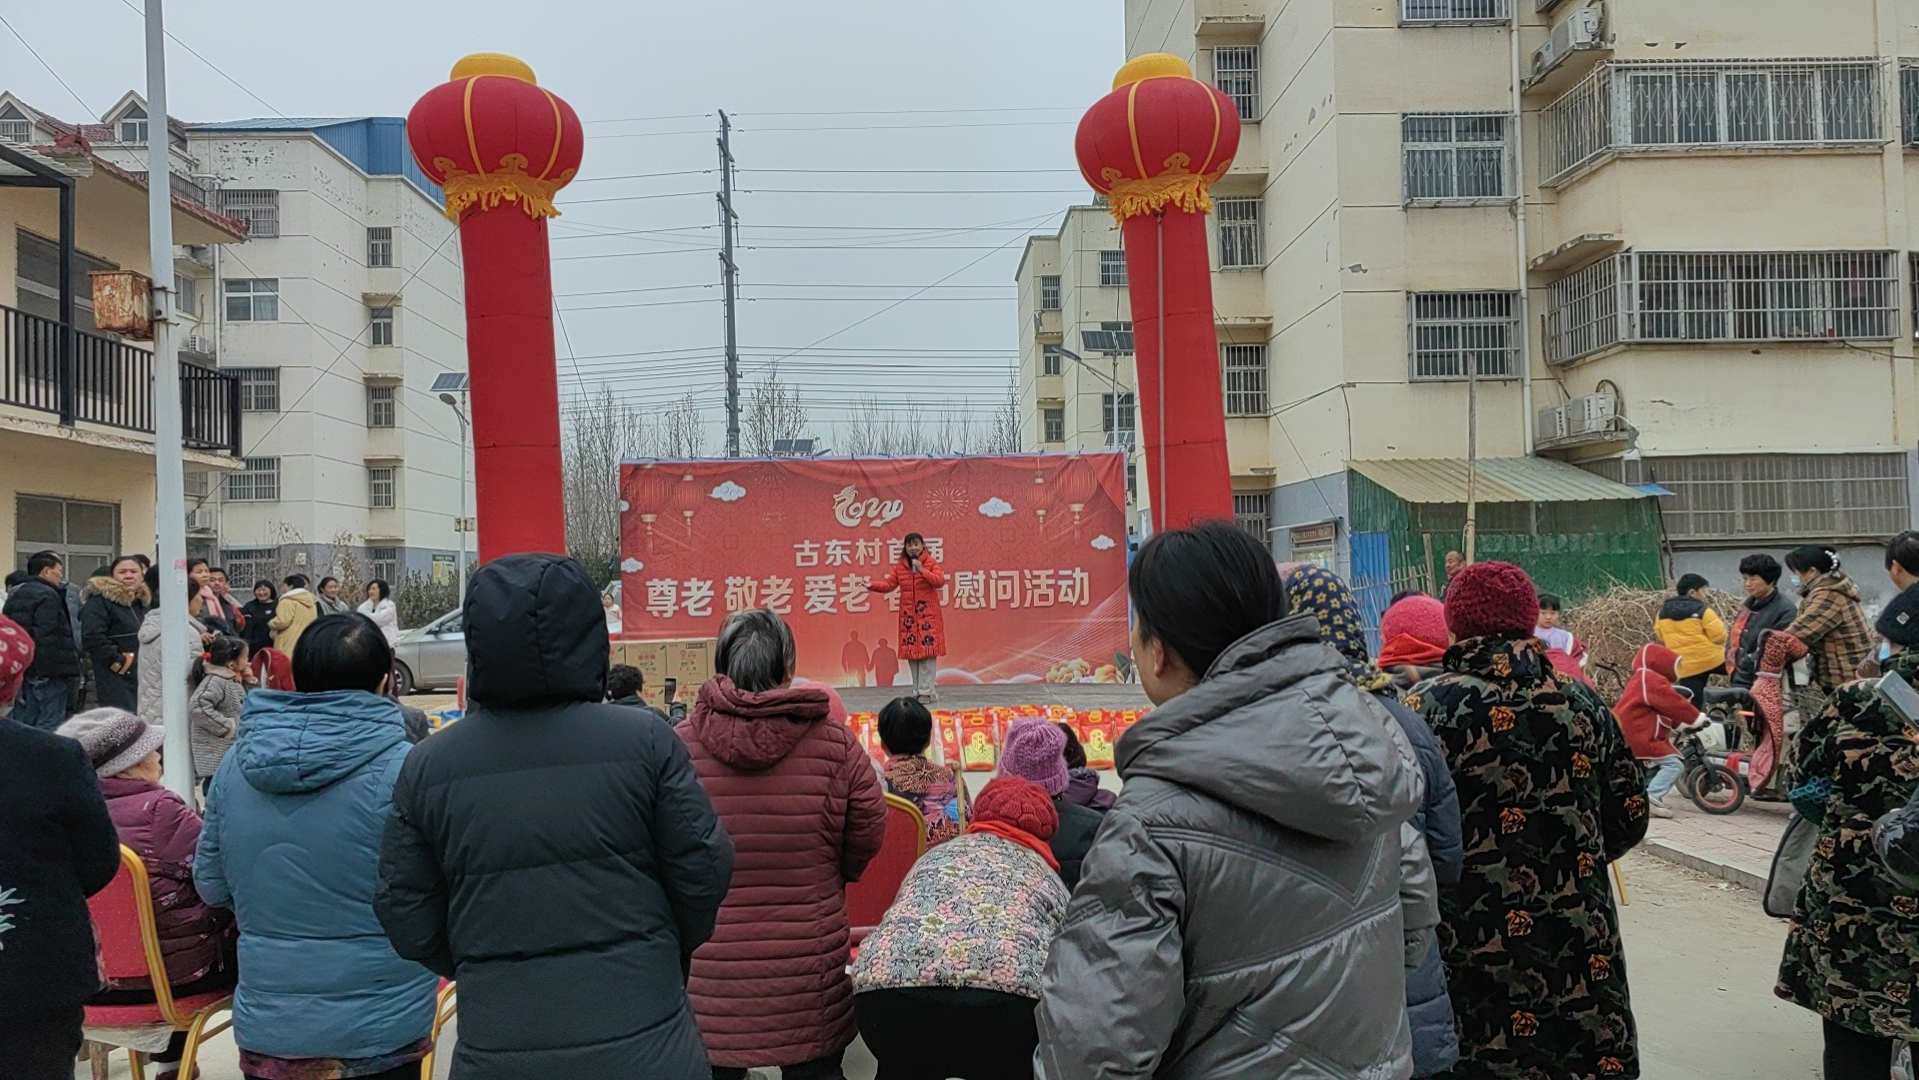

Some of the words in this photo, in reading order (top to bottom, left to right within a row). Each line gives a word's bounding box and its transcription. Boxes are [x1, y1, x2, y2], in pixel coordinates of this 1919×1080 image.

[645, 577, 715, 618] 尊老
[724, 575, 794, 615] 敬老
[804, 573, 872, 615] 爱老
